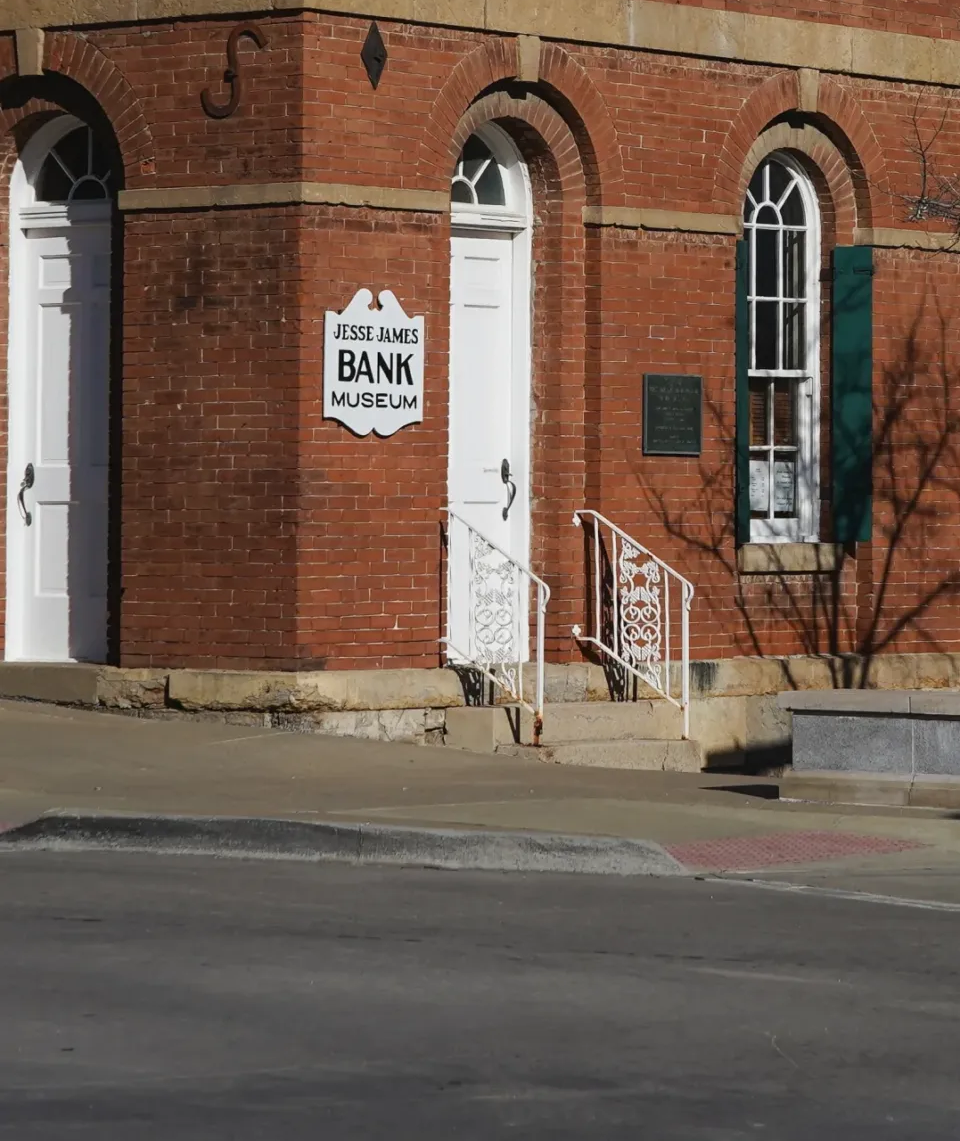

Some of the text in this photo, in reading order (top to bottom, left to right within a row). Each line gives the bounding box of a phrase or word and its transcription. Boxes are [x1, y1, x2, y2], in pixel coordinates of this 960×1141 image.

[333, 323, 419, 344] JESSE JAMES
[338, 349, 414, 385] BANK
[331, 391, 417, 409] MUSEUM
